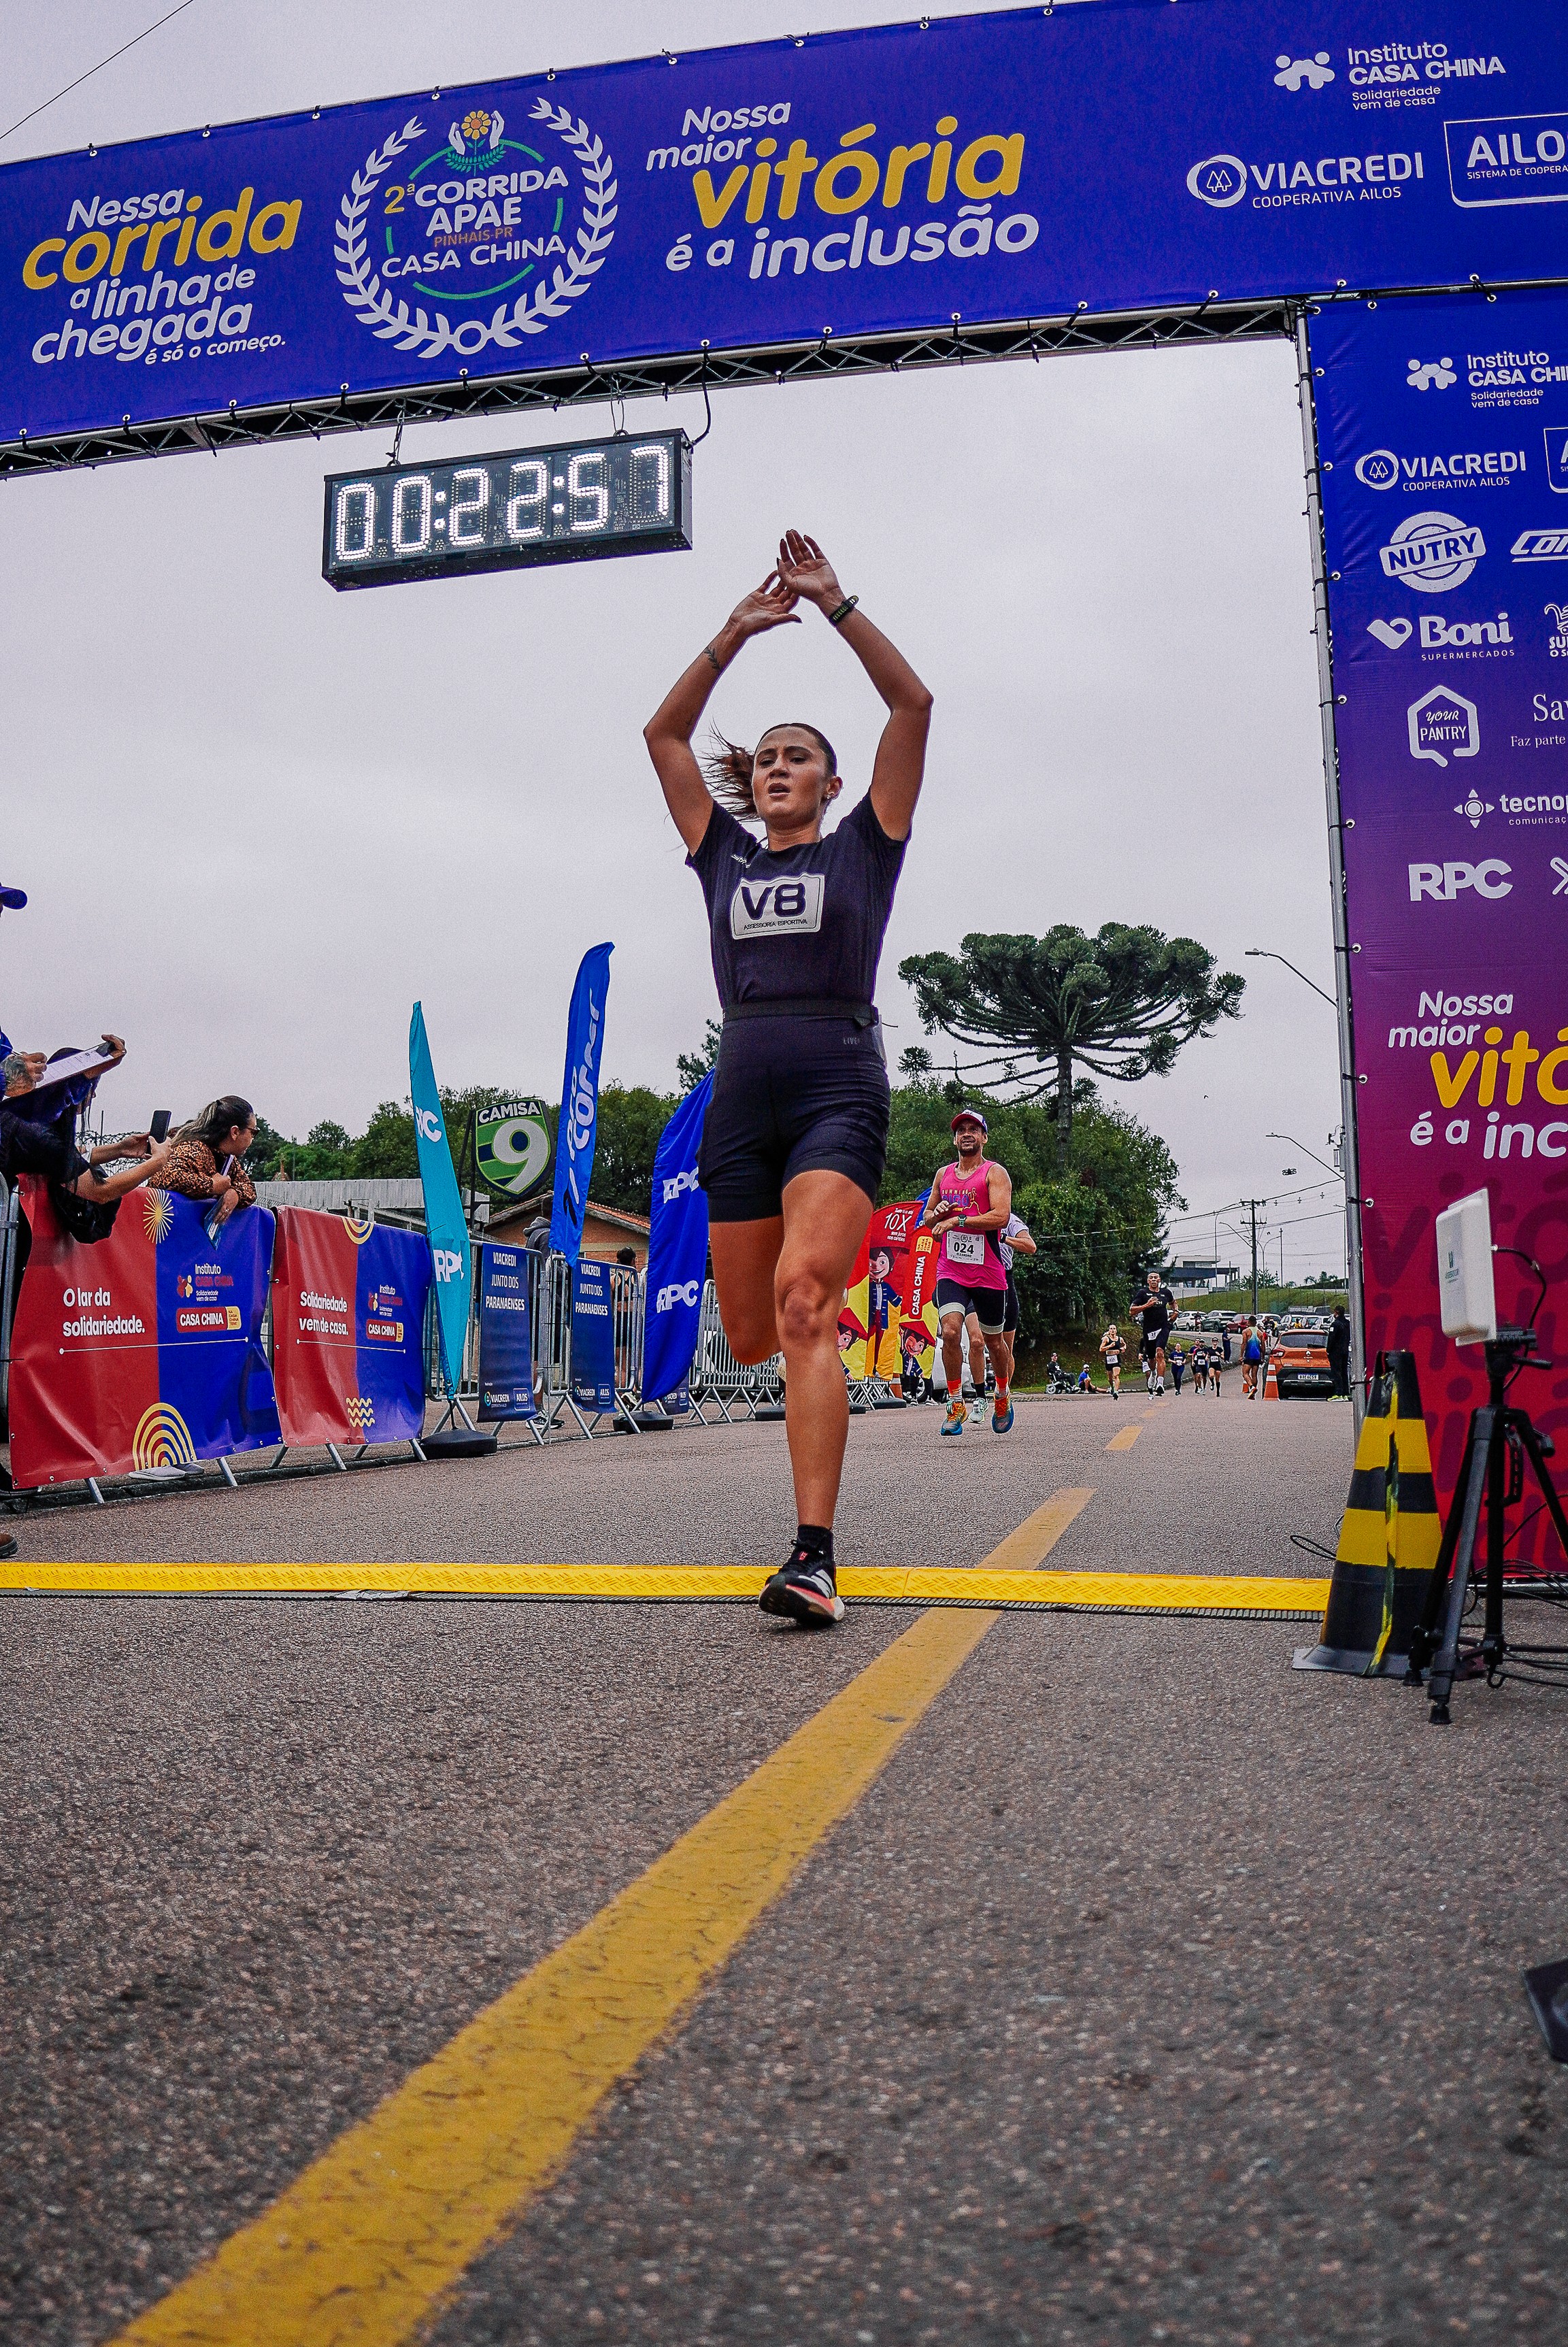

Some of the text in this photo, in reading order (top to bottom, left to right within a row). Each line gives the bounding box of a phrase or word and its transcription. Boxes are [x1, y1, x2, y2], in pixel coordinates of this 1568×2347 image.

[1347, 41, 1448, 65] Instituto
[1349, 56, 1506, 86] CASA CHINA
[1352, 86, 1441, 101] Solidariedade
[1352, 96, 1436, 111] vem de casa
[682, 102, 791, 137] Nossa
[646, 135, 752, 171] maior
[1467, 130, 1568, 167] AILO
[693, 116, 1025, 229] vitória
[1250, 152, 1424, 191] VIACREDI
[1467, 169, 1507, 180] SISTEMA
[1509, 168, 1522, 176] DE
[415, 166, 569, 207] CORRIDA
[1252, 186, 1401, 208] COOPERATIVA AILOS
[67, 188, 184, 231] Nessa
[426, 197, 522, 237] APAE
[22, 187, 302, 290] corrida
[434, 227, 513, 248] PINHAIS-PR
[665, 203, 1039, 280] é a inclusão
[382, 235, 567, 278] CASA CHINA
[70, 263, 256, 320] a linha de
[32, 297, 252, 364] chegada
[145, 331, 286, 365] é só o começo.
[1467, 350, 1550, 369] Instituto
[1468, 369, 1526, 387] CASA
[1471, 388, 1544, 401] Solidariedade
[1471, 397, 1539, 408] vem de casa
[1401, 451, 1527, 478] VIACREDI
[1403, 477, 1510, 492] COOPERATIVA AILOS
[336, 445, 669, 560] 00:22:57
[1388, 532, 1478, 571] NUTRY
[1419, 612, 1514, 648] Boni
[1421, 649, 1515, 661] SUPERMERCADOS
[1426, 710, 1459, 725] YOUR
[1420, 725, 1467, 742] PANTRY
[1510, 734, 1566, 748] Faz parte
[1408, 859, 1513, 901] RPC
[741, 882, 806, 920] V8
[744, 921, 776, 930] ASSESSORIA
[1418, 991, 1514, 1018] Nossa
[1388, 1018, 1481, 1048] maior
[479, 1102, 540, 1124] CAMISA
[1409, 1111, 1568, 1159] é a inc
[493, 1118, 548, 1194] 9
[884, 1212, 912, 1232] 10X
[195, 1263, 221, 1275] Instituto
[493, 1252, 516, 1267] VIACREDI
[581, 1263, 601, 1277] VIACREDI
[380, 1284, 396, 1295] Instituto
[491, 1274, 519, 1288] JUNTO DOS
[580, 1283, 603, 1297] JUNTO DOS
[912, 1256, 926, 1316] CASA CHINA
[63, 1287, 111, 1308] O lar da
[300, 1291, 348, 1313] Solidariedade
[486, 1295, 525, 1311] PARANAENSES
[656, 1280, 699, 1314] RPC
[180, 1312, 224, 1327] CASA CHINA
[575, 1301, 608, 1316] PARANAENSES
[63, 1314, 146, 1337] solidariedade.
[299, 1317, 348, 1335] vem de casa.
[368, 1324, 380, 1335] CASA
[381, 1325, 395, 1337] CHINA
[490, 1393, 528, 1403] VIACREDI AILOS
